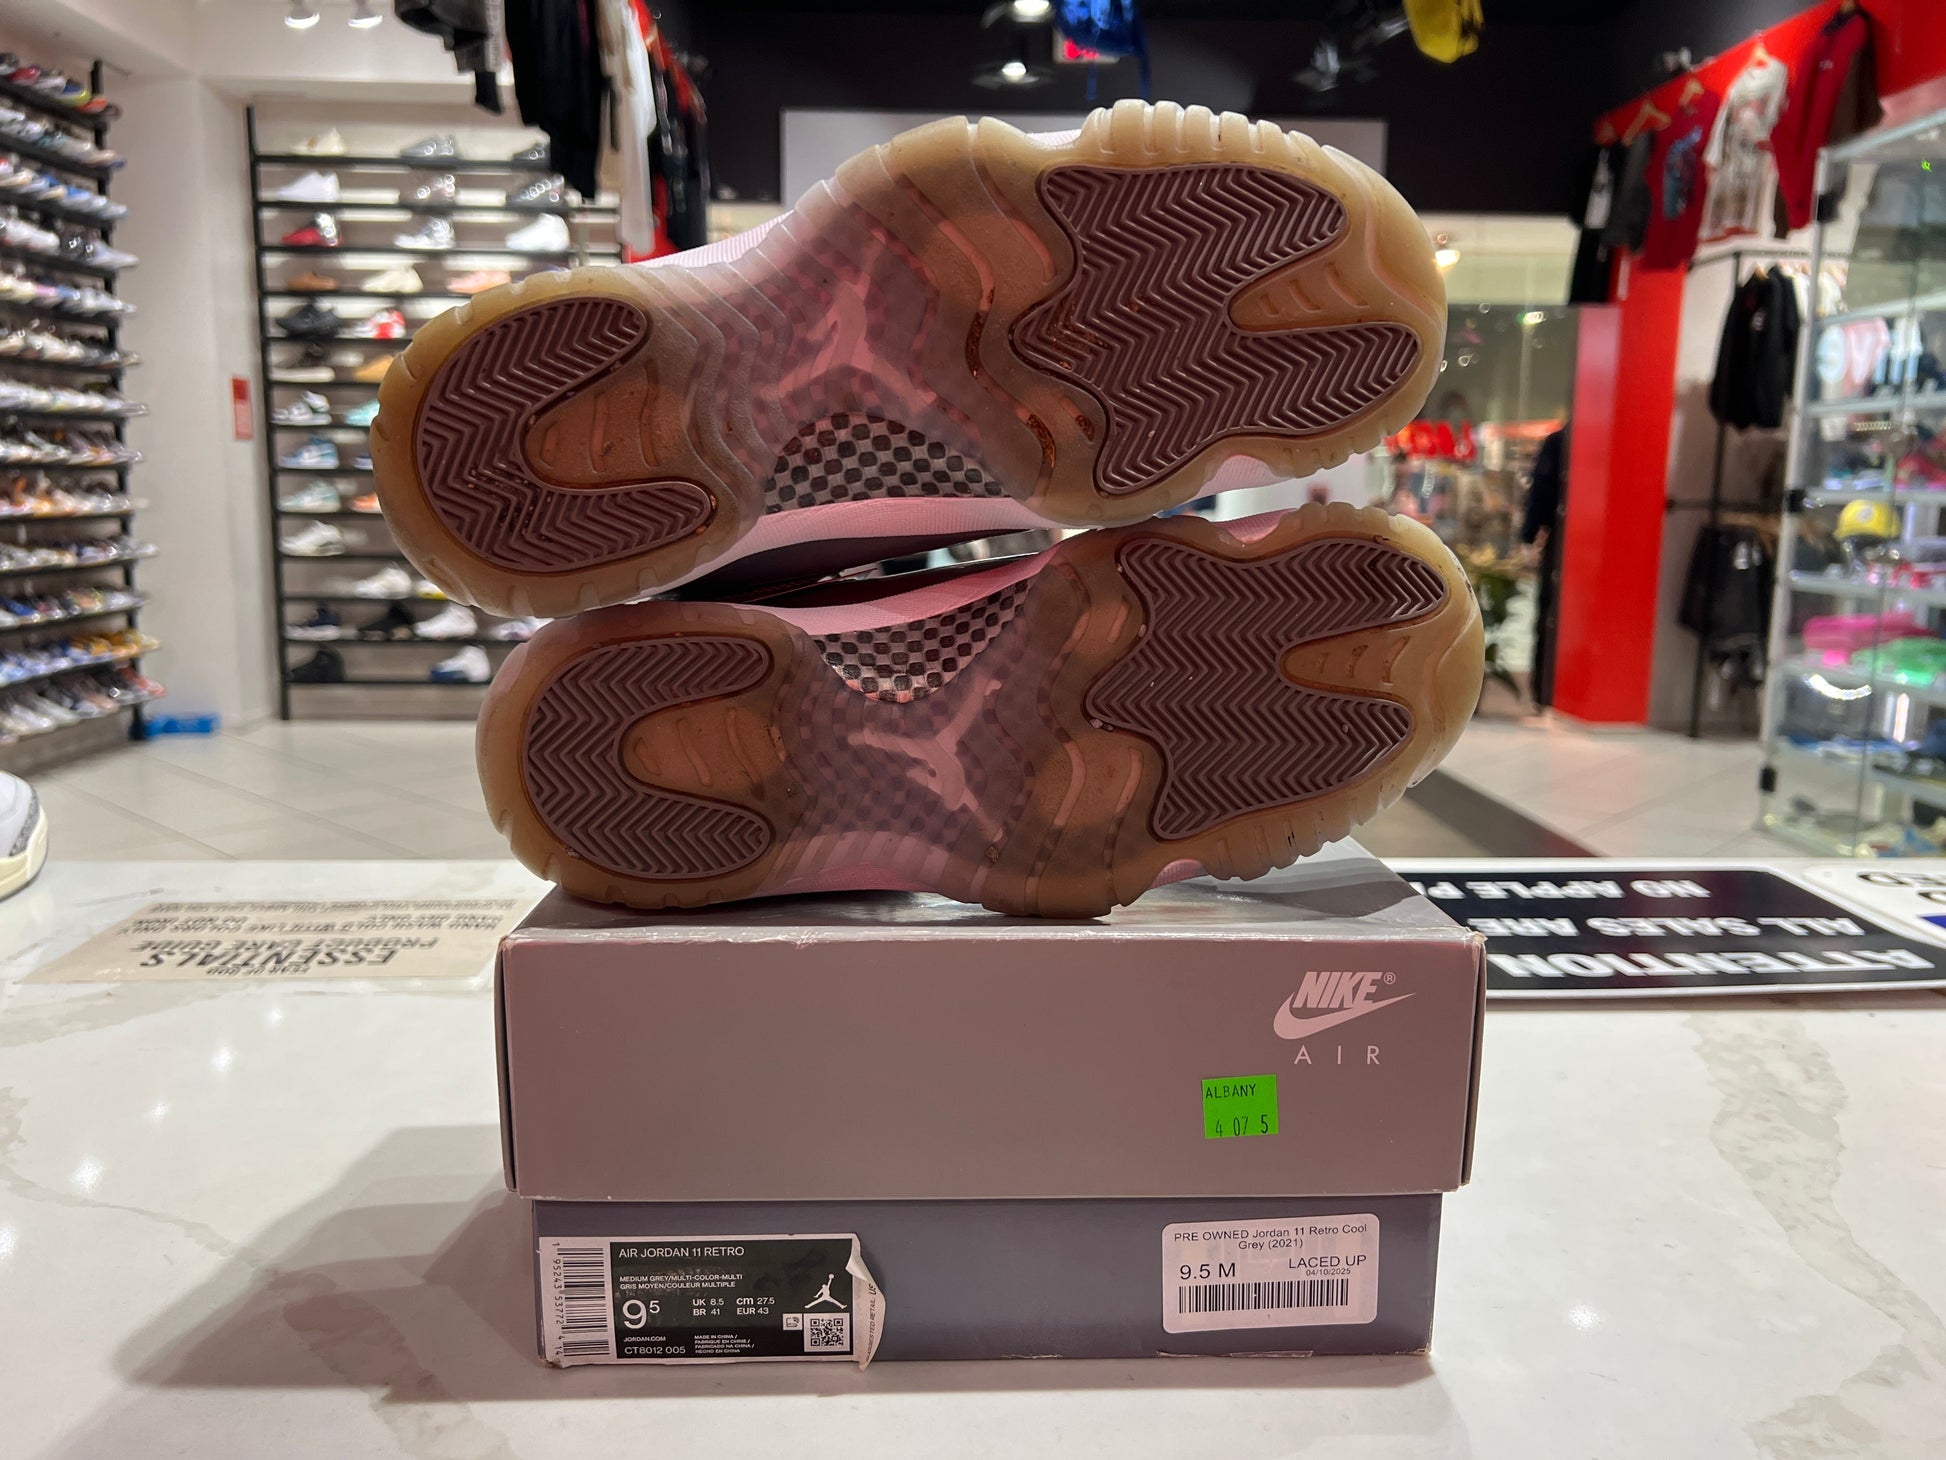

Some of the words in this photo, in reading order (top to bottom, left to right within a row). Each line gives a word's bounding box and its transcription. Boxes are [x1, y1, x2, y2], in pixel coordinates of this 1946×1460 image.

[1465, 880, 1627, 899] APPLE
[1630, 880, 1711, 899] NO
[1466, 917, 1580, 937] ARE
[1586, 917, 1761, 936] SALES
[1758, 917, 1866, 936] ALL
[302, 936, 440, 949] PRODUCT
[139, 950, 399, 967] ESSENTIALS
[1487, 949, 1935, 978] ATTENTION
[1293, 1045, 1381, 1065] AIR
[1205, 1083, 1257, 1099] ALBANY
[1260, 1114, 1270, 1135] 5
[1174, 1231, 1199, 1242] PRE
[1202, 1229, 1249, 1241] OWNED
[1252, 1228, 1290, 1239] Jordan
[1294, 1227, 1305, 1236] 11
[1309, 1225, 1339, 1235] Retro
[1342, 1223, 1367, 1234] Cool
[618, 1248, 638, 1258] AIR
[640, 1247, 689, 1258] JORDAN
[692, 1247, 701, 1256] 11
[704, 1246, 745, 1256] RETRO
[1238, 1240, 1265, 1251] Grey
[1268, 1239, 1304, 1250] (2021)
[1288, 1256, 1341, 1269] LACED
[1345, 1254, 1367, 1267] UP
[552, 1259, 563, 1289] 95243
[1179, 1263, 1211, 1280] 9.5
[1218, 1262, 1236, 1278] M
[1305, 1267, 1351, 1276] 04/10/2025
[638, 1282, 700, 1290] MOYEN/COULEUR
[554, 1296, 565, 1324] 53772
[692, 1298, 706, 1306] UK
[710, 1298, 724, 1306] 8.5
[736, 1297, 754, 1305] cm
[756, 1297, 775, 1305] 27.5
[692, 1308, 707, 1316] BR
[710, 1308, 721, 1316] 41
[736, 1307, 756, 1315] EUR
[624, 1346, 662, 1354] CT8012
[665, 1346, 686, 1354] 005
